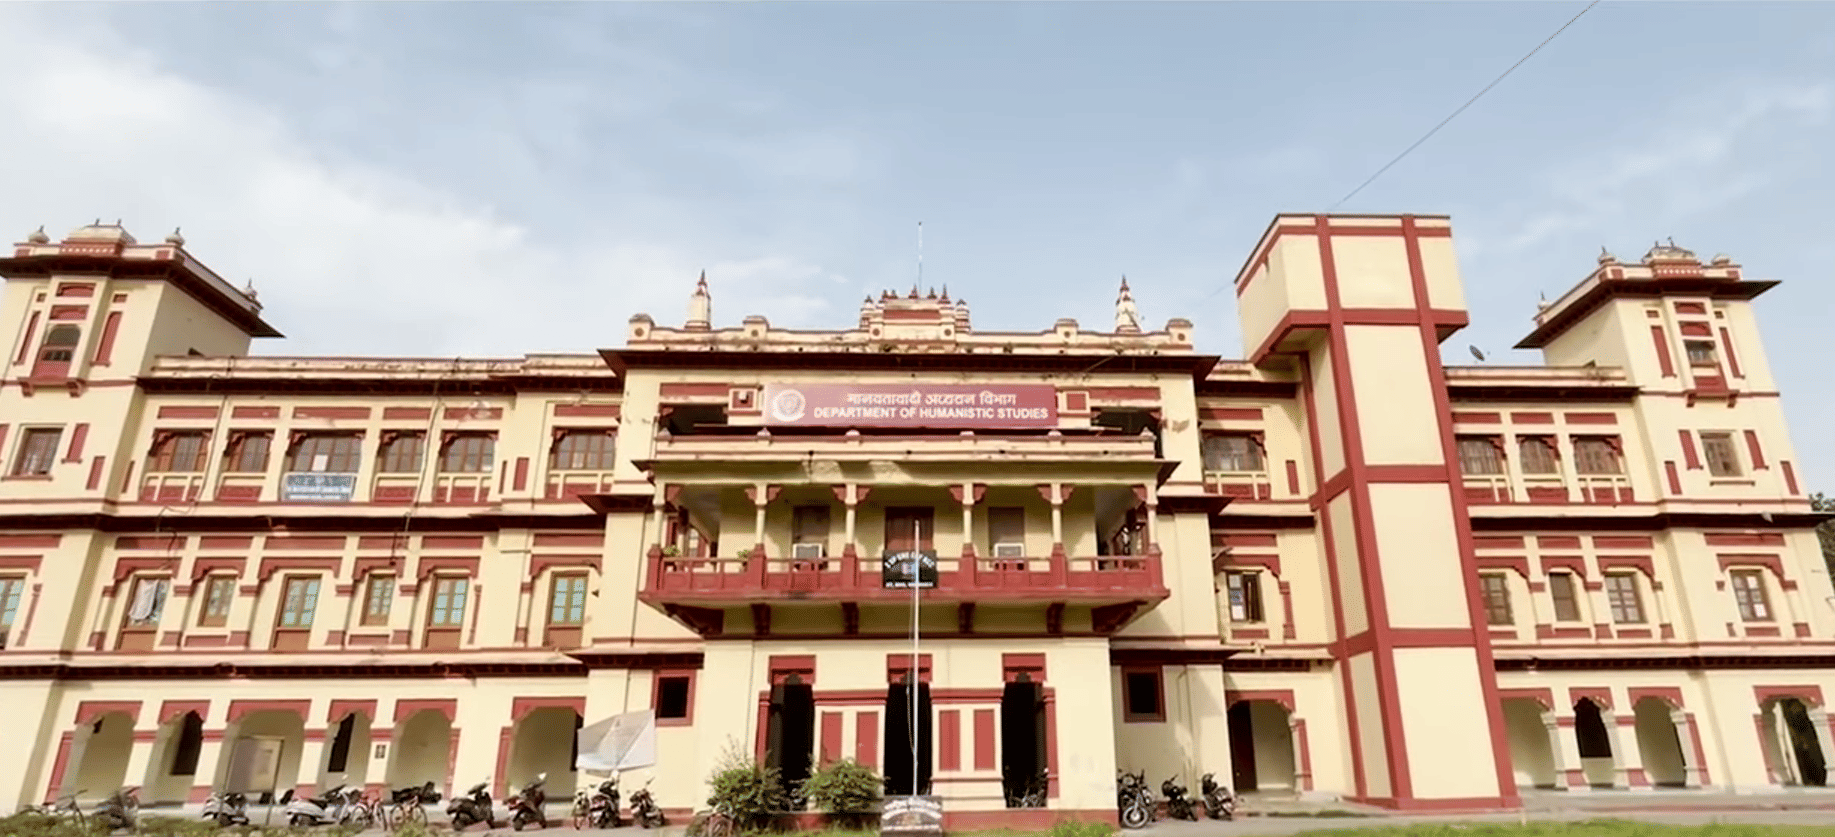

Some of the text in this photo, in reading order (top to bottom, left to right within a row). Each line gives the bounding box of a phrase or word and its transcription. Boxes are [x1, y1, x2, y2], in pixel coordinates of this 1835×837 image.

[979, 390, 1017, 405] विभाग
[814, 407, 1048, 419] DEPARTMENT OF HUMANISTIC STUDIES
